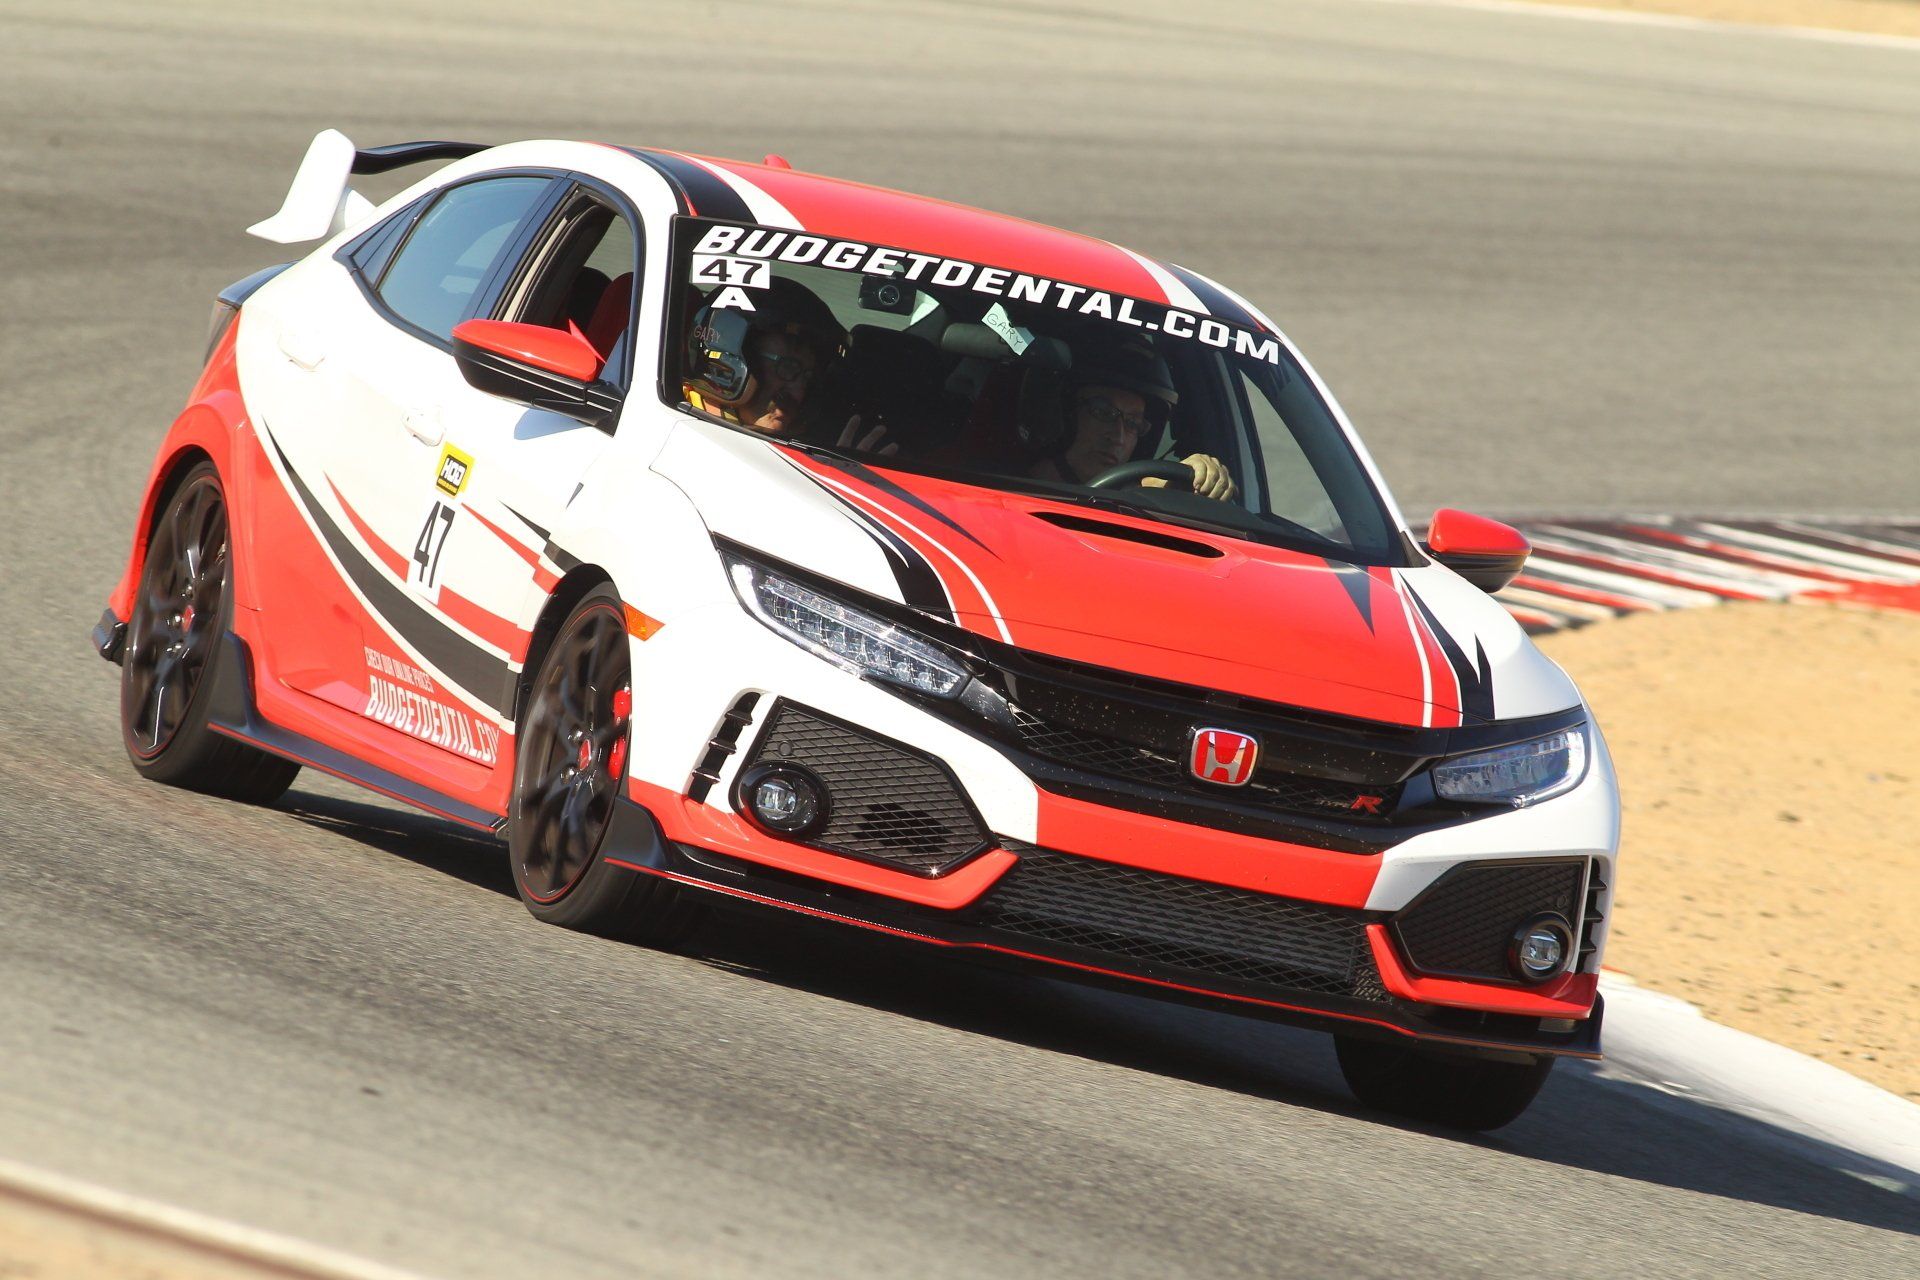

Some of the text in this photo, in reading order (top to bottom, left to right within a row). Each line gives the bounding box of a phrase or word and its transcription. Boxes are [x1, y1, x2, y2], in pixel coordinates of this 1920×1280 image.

[700, 259, 763, 285] 47
[692, 225, 1279, 365] BUDGETDENTAL.COM
[710, 286, 757, 312] A
[986, 313, 1024, 347] GARY
[413, 500, 456, 588] 47
